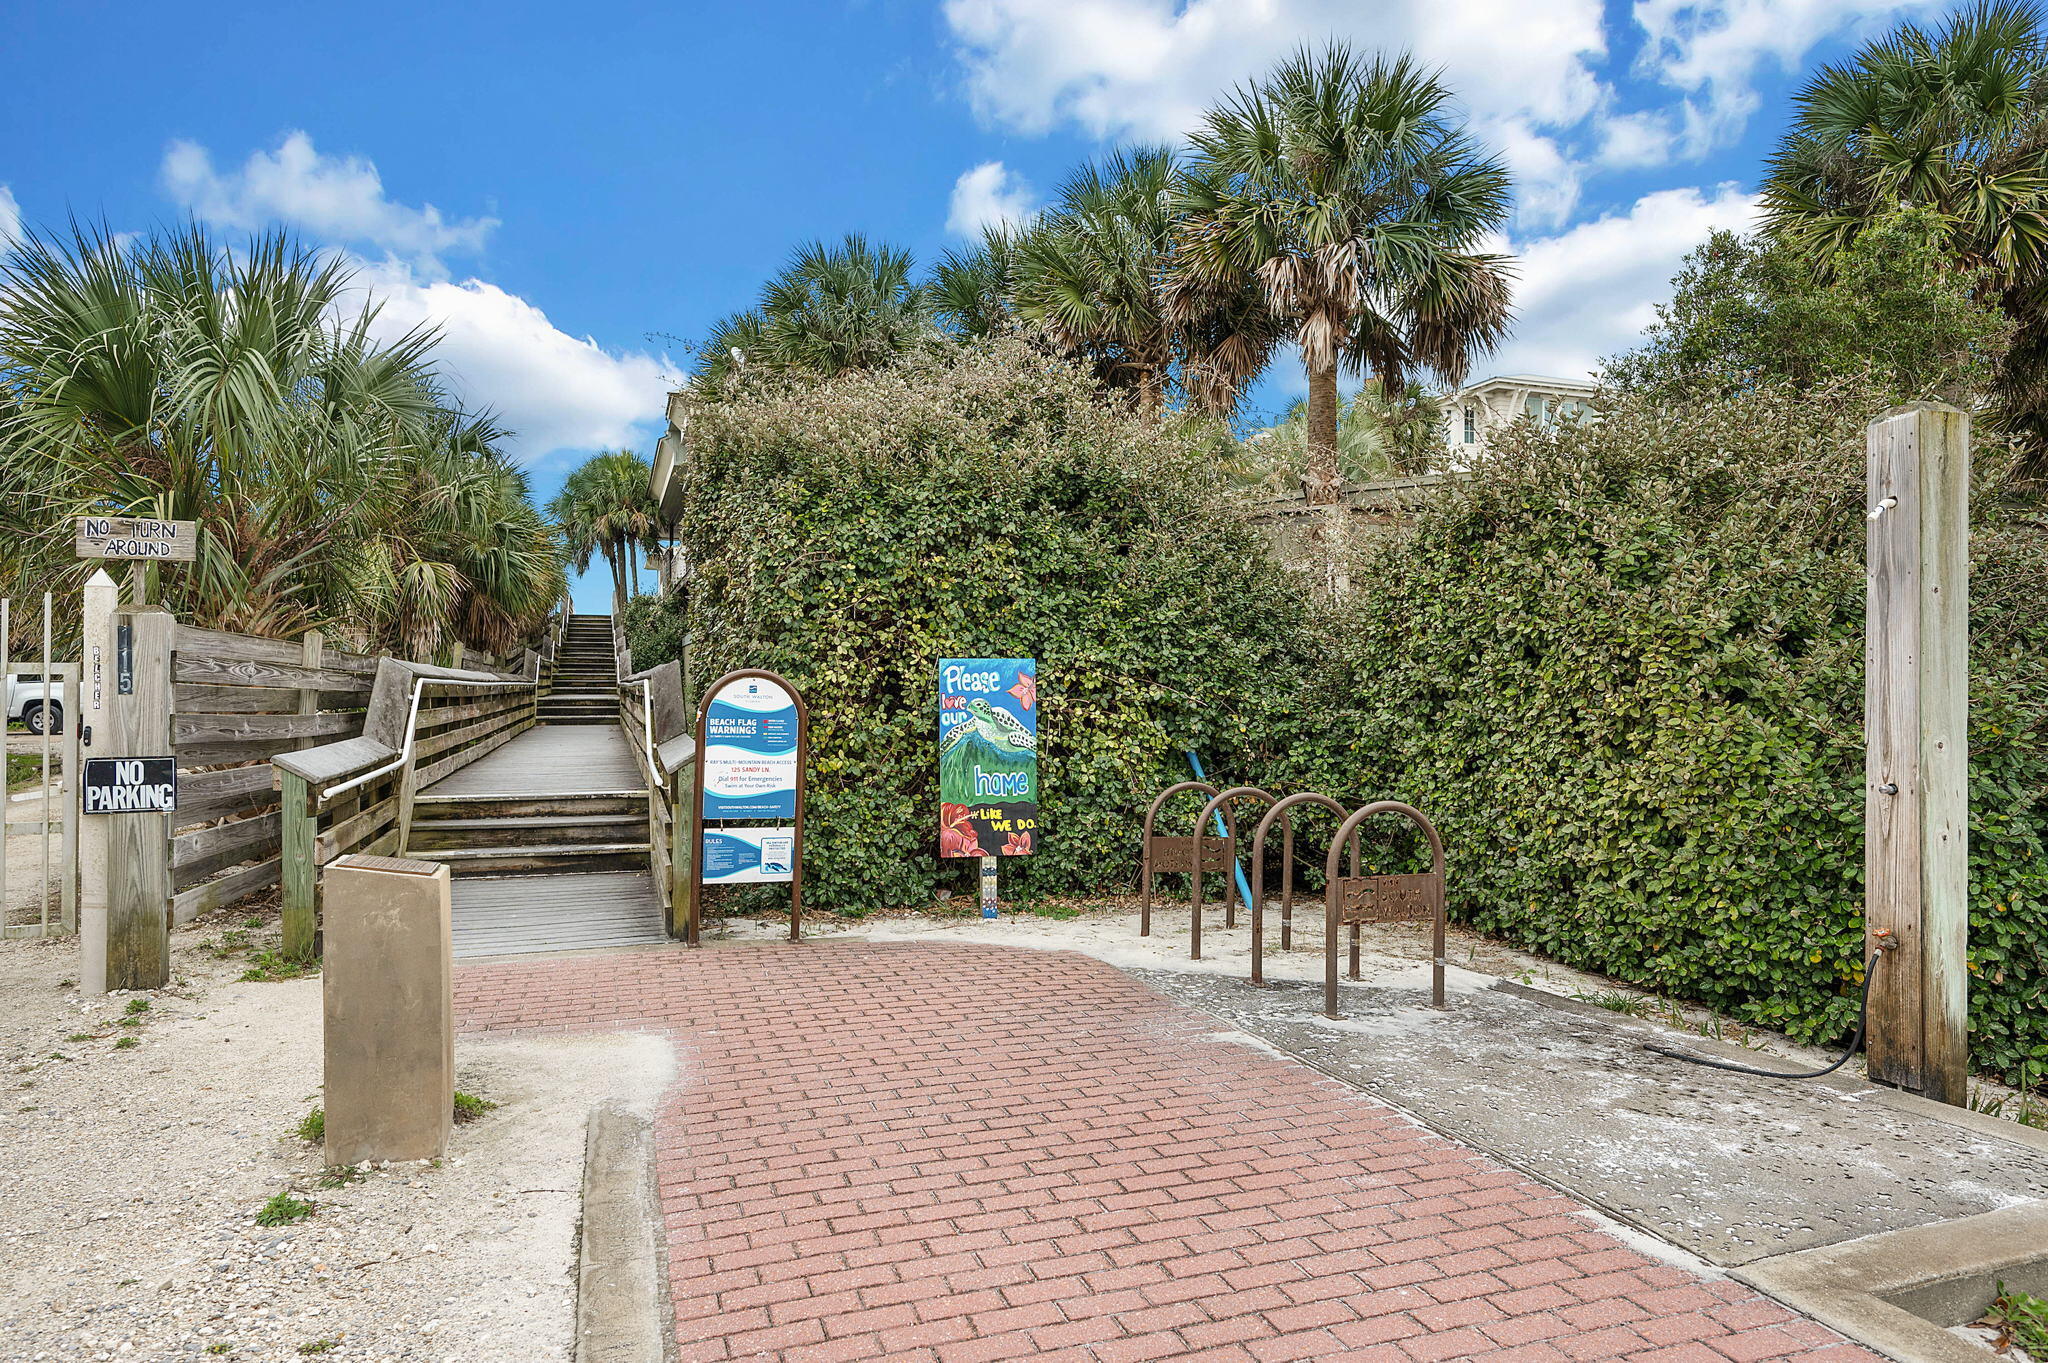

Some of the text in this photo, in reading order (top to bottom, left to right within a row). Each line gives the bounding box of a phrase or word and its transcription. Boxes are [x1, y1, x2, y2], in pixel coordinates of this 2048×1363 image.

[84, 518, 177, 539] NO TURN
[103, 539, 171, 556] AROUND
[92, 646, 101, 709] BELCHER
[942, 665, 1001, 694] Please
[709, 718, 757, 726] BEACH FLAG
[941, 711, 967, 726] our
[709, 726, 757, 735] WARNINGS
[115, 760, 145, 786] NO
[87, 784, 173, 810] PARKING
[991, 819, 1037, 832] WE DO.
[1380, 888, 1422, 902] SOUTH
